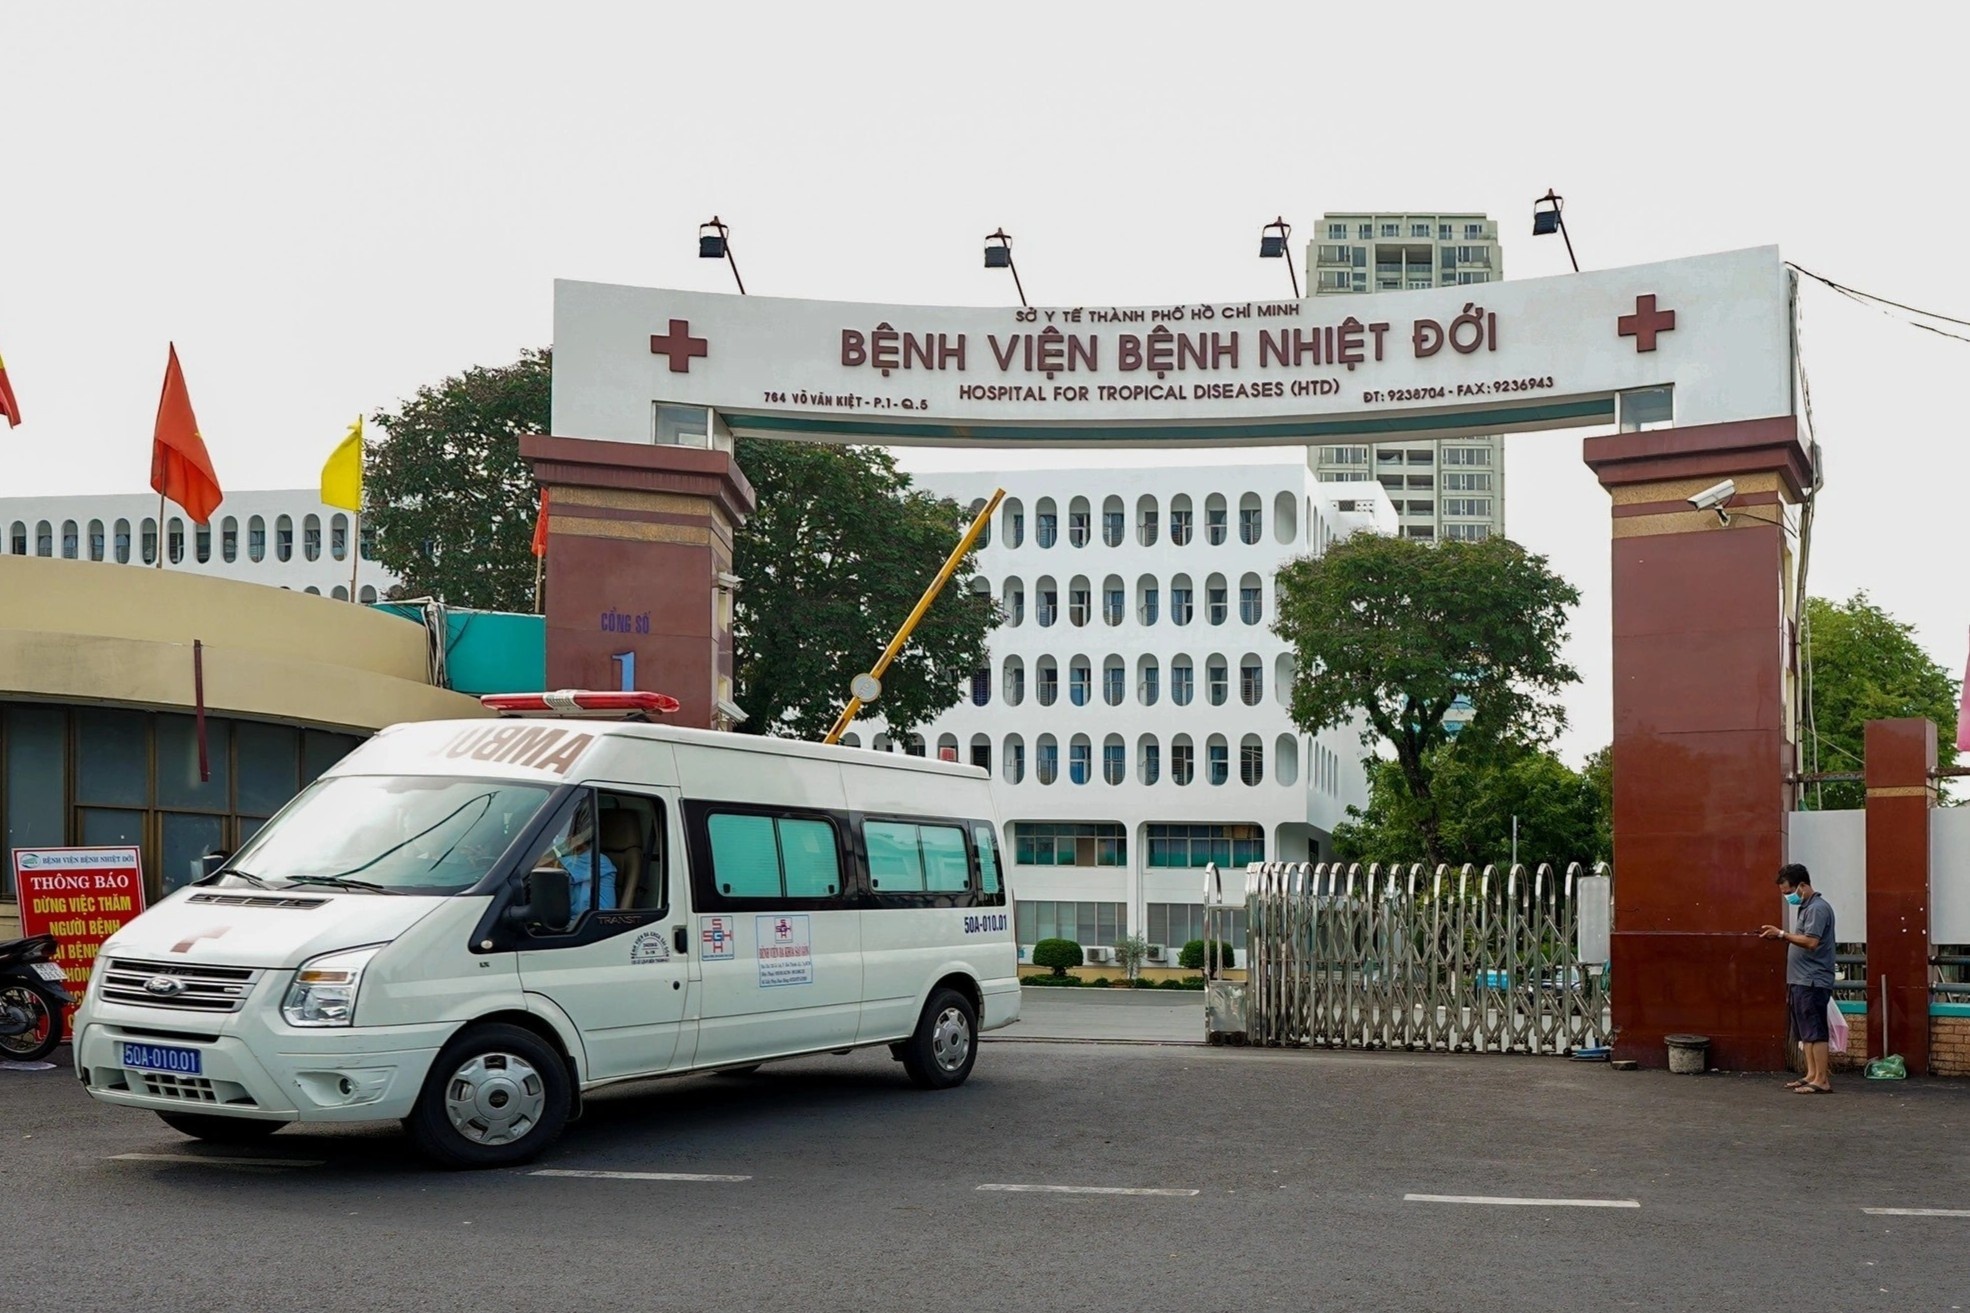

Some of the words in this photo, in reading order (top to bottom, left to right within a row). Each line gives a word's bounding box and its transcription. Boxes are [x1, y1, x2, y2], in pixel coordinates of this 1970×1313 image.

[1015, 307, 1037, 322] SỞ
[1044, 310, 1056, 322] Y
[1062, 307, 1083, 322] TẾ
[1089, 307, 1145, 322] THÀNH
[1151, 305, 1185, 321] PHỐ
[1191, 304, 1215, 320] HỒ
[1221, 303, 1251, 319] CHÍ
[1257, 303, 1299, 317] MINH
[840, 321, 966, 378] BỆNH
[987, 325, 1098, 380] VIỆN
[1118, 324, 1239, 380] BỆNH
[1259, 316, 1390, 371] NHIỆT
[1412, 302, 1497, 359] ĐỚI
[764, 391, 786, 403] 764
[836, 393, 863, 409] KIỆT
[959, 384, 1047, 402] HOSPITAL
[1053, 385, 1090, 401] FOR
[1097, 383, 1188, 401] TROPICAL
[1193, 380, 1285, 400] DISEASES
[1291, 378, 1340, 397] (HTD)
[1363, 391, 1385, 403] ĐT:
[1387, 386, 1445, 402] 9238704
[1457, 382, 1491, 397] FAX:
[1493, 376, 1555, 393] 9236943
[601, 606, 632, 633] CỔNG
[635, 610, 651, 634] SỐ
[611, 650, 636, 692] 1
[31, 872, 90, 890] THÔNG
[94, 872, 129, 889] BÁO
[33, 895, 67, 914] DỪNG
[68, 894, 96, 915] VIỆC
[97, 893, 132, 912] THĂM
[49, 917, 87, 936] NGƯỜI
[89, 917, 120, 938] BỆNH
[964, 914, 1007, 934] 50A-010.01
[125, 1044, 197, 1072] 50A-010.01
